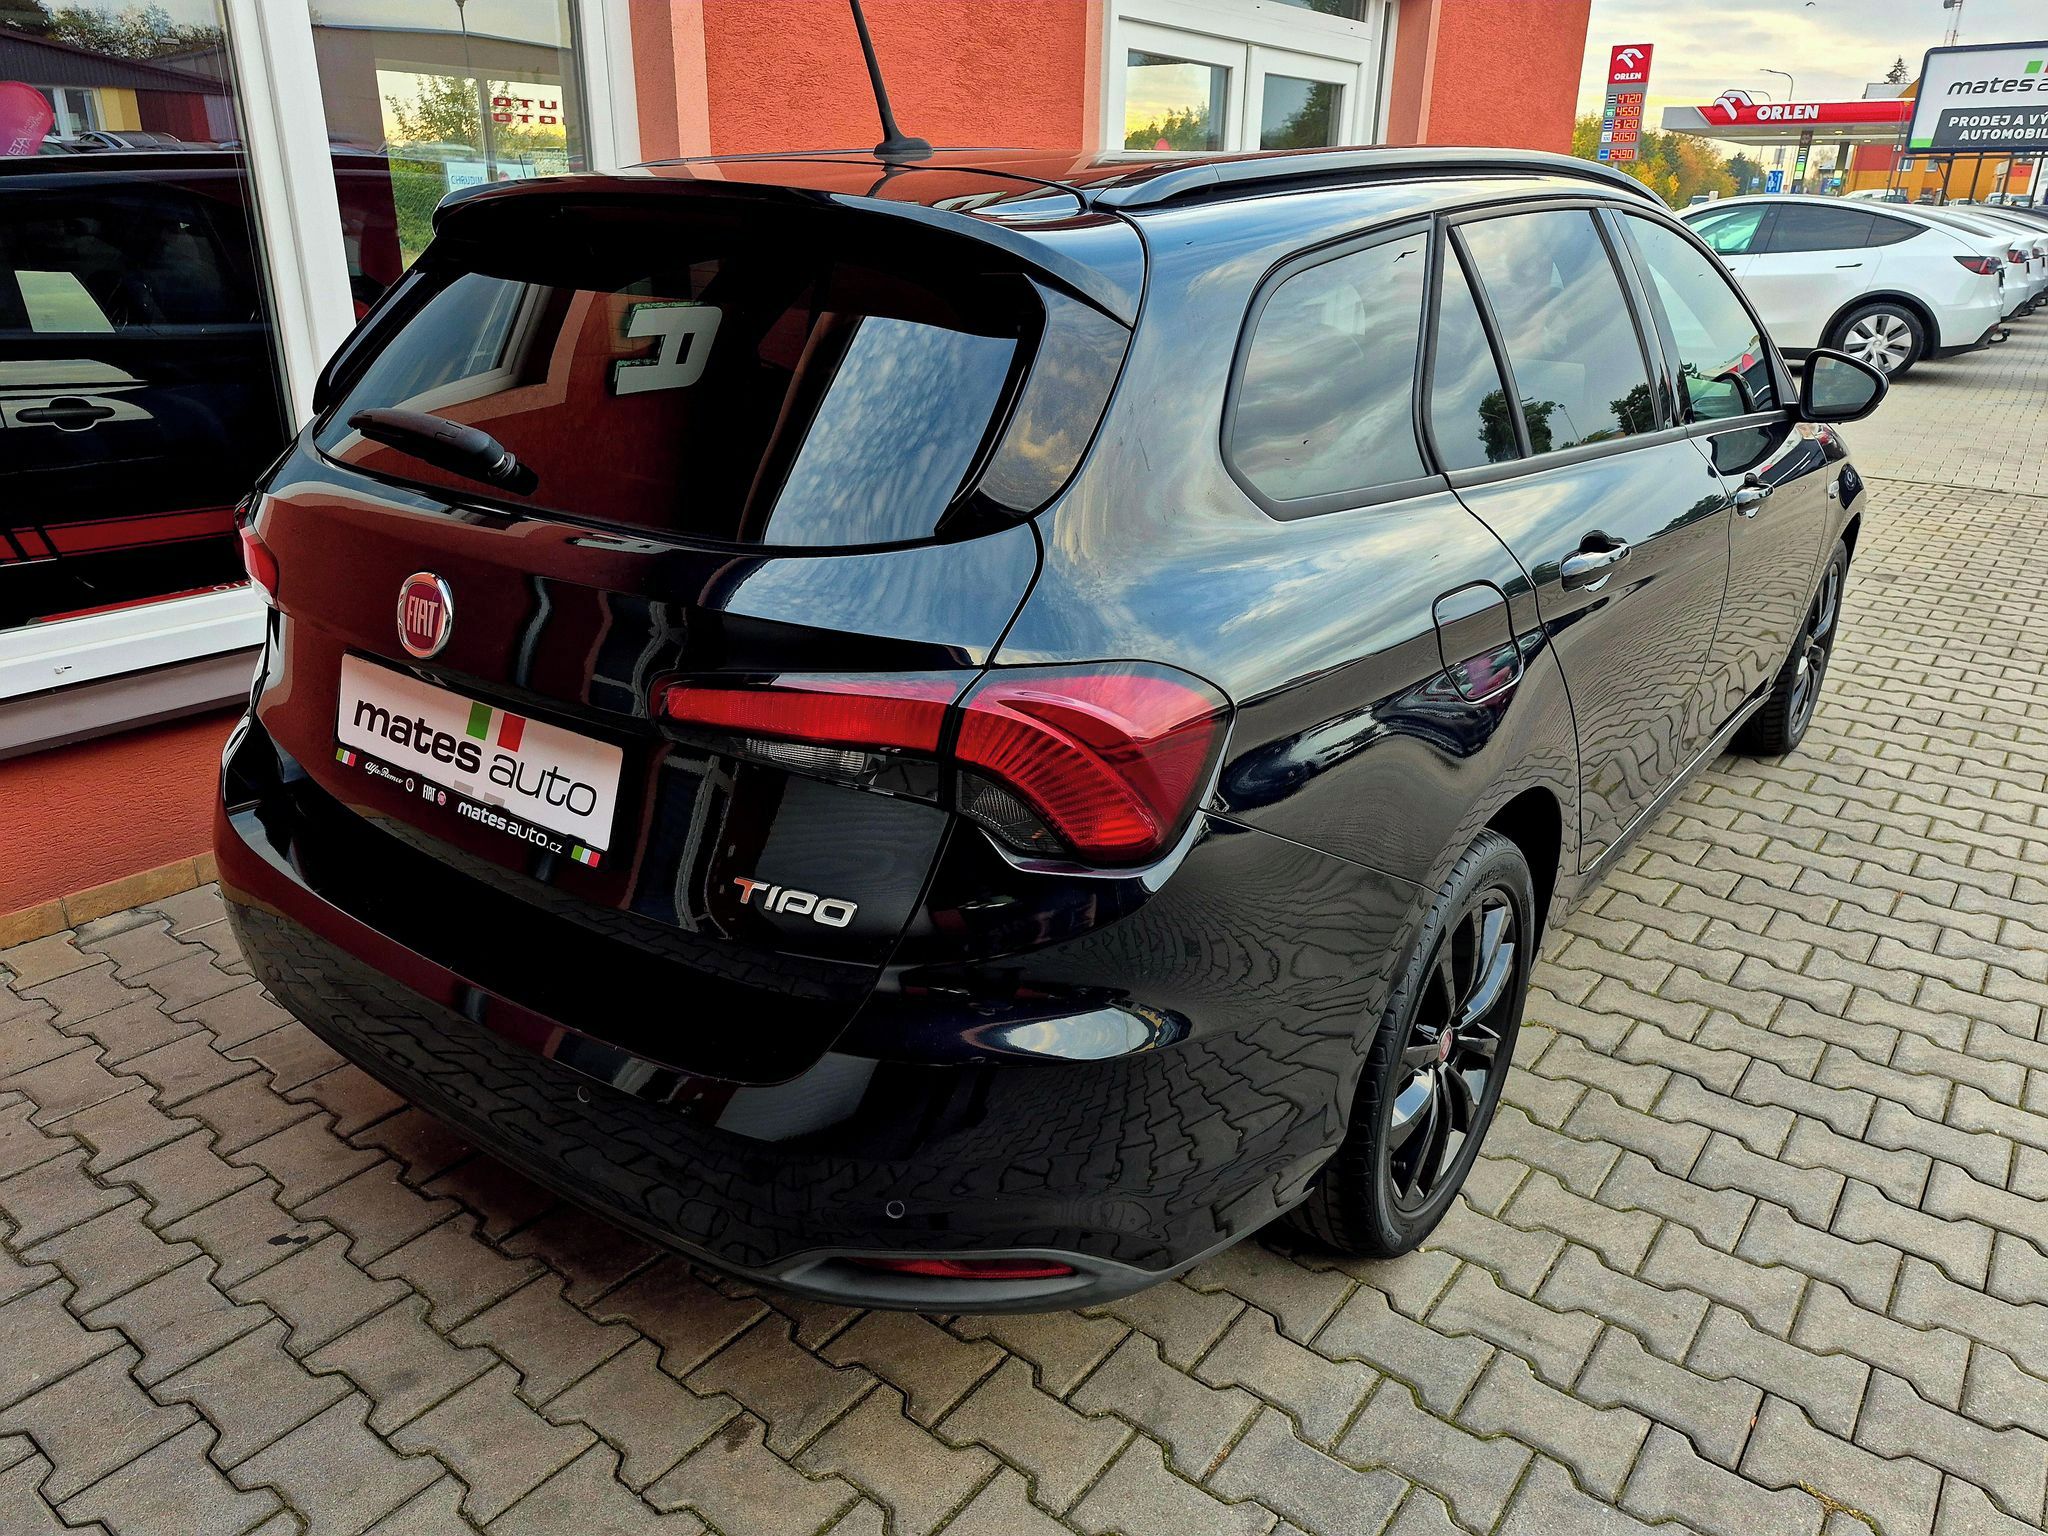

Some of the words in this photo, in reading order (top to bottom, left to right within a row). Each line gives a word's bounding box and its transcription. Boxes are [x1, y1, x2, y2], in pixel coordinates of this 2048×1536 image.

[1614, 72, 1642, 80] ORLEN
[1946, 77, 2036, 95] mates
[1756, 105, 1820, 120] ORLEN
[1948, 115, 2011, 127] PRODEJ
[2012, 115, 2024, 126] A
[406, 595, 439, 638] FIAT
[353, 698, 482, 775] mates
[488, 753, 597, 818] auto
[364, 761, 381, 775] Alfa
[380, 767, 404, 784] Romeo
[422, 784, 437, 802] FIAT
[733, 876, 858, 928] TIPO
